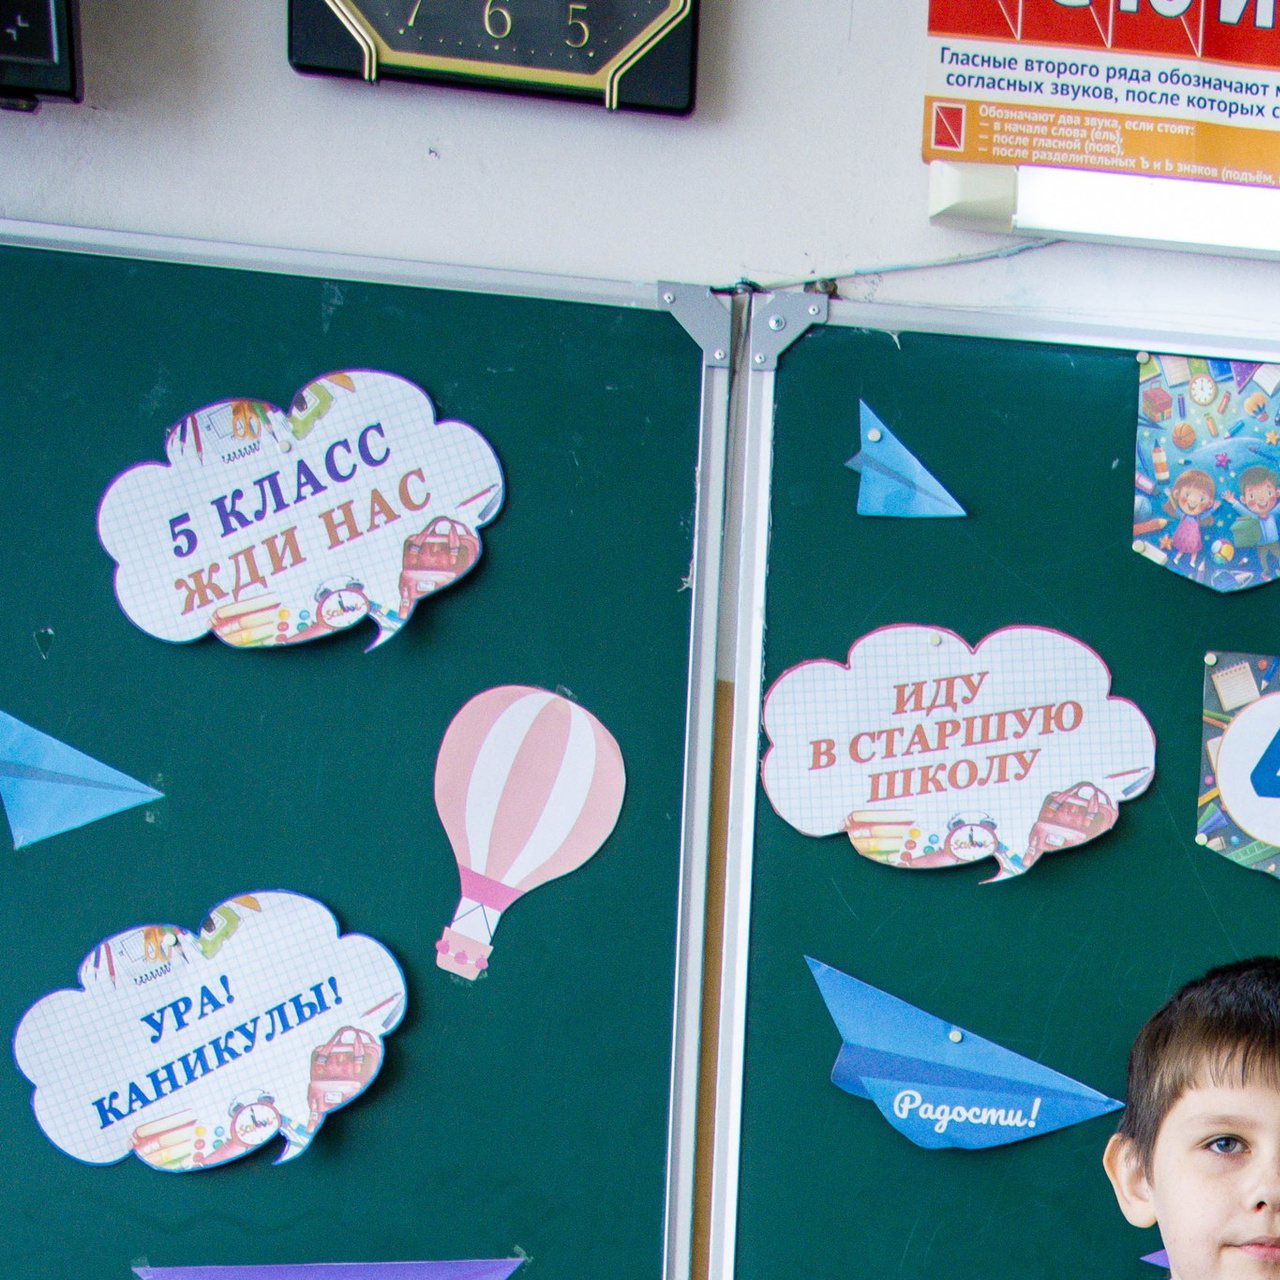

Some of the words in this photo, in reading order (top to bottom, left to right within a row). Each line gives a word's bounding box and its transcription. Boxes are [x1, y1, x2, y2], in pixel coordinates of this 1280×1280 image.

[484, 0, 512, 38] 6
[565, 4, 590, 48] 5
[940, 46, 1018, 71] Гласные
[1024, 57, 1100, 79] второго
[1106, 65, 1152, 84] ряда
[1158, 68, 1270, 97] обозначают
[946, 71, 1044, 95] согласных
[1051, 81, 1120, 104] звуков,
[1126, 88, 1180, 107] после
[1187, 94, 1266, 118] которых
[978, 104, 1056, 123] Обозначают
[1058, 114, 1081, 127] два
[1125, 119, 1154, 132] если
[1157, 122, 1196, 136] стоят:
[993, 133, 1029, 147] после
[1033, 136, 1081, 150] гласной
[1004, 122, 1048, 135] начале
[1051, 127, 1087, 138] слова
[992, 145, 1028, 159] после
[1032, 148, 1136, 169] разделительных
[1177, 162, 1218, 177] знаков
[168, 513, 198, 558] 5
[211, 422, 391, 538] КЛАСС
[174, 527, 306, 616] ЖДИ
[318, 468, 431, 550] НАС
[892, 671, 990, 716] ИДУ
[808, 739, 837, 771] В
[848, 700, 1083, 764] СТАРШУЮ
[866, 748, 1042, 803] ШКОЛУ
[140, 974, 235, 1044] УРА!
[91, 976, 343, 1130] КАНИКУЛЫ!
[893, 1089, 1042, 1134] Радости!
